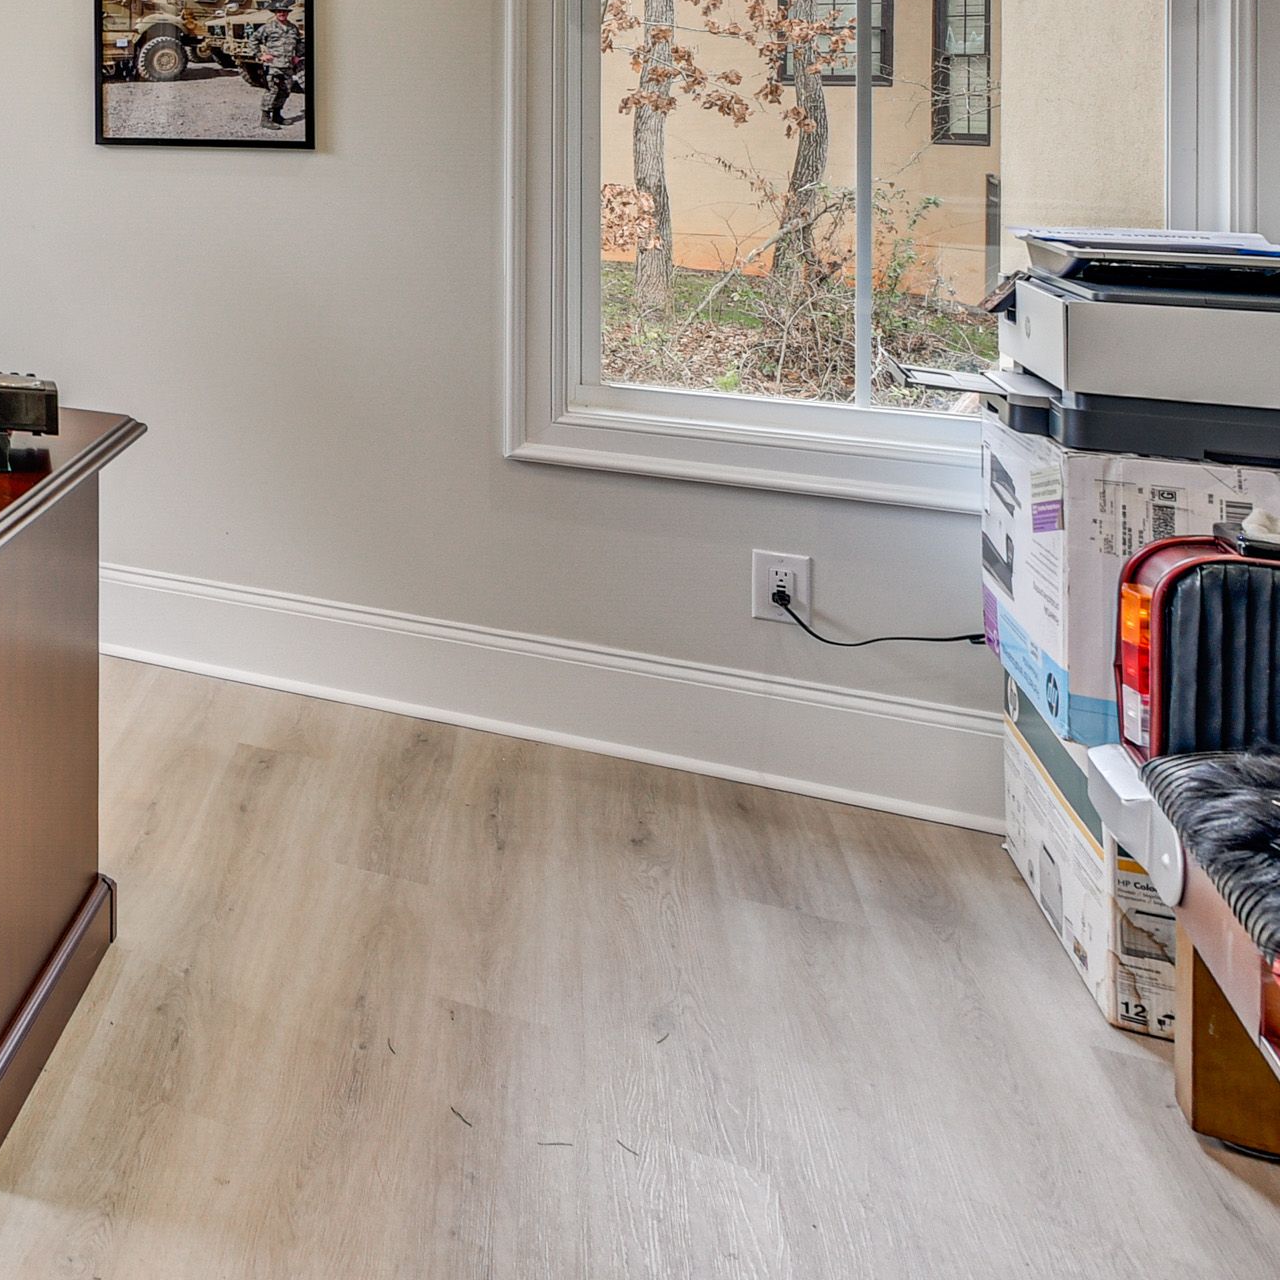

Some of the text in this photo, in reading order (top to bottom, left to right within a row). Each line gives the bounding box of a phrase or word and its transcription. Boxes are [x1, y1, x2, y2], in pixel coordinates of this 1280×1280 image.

[1117, 878, 1158, 893] HP Colo
[1121, 1001, 1146, 1018] 12
